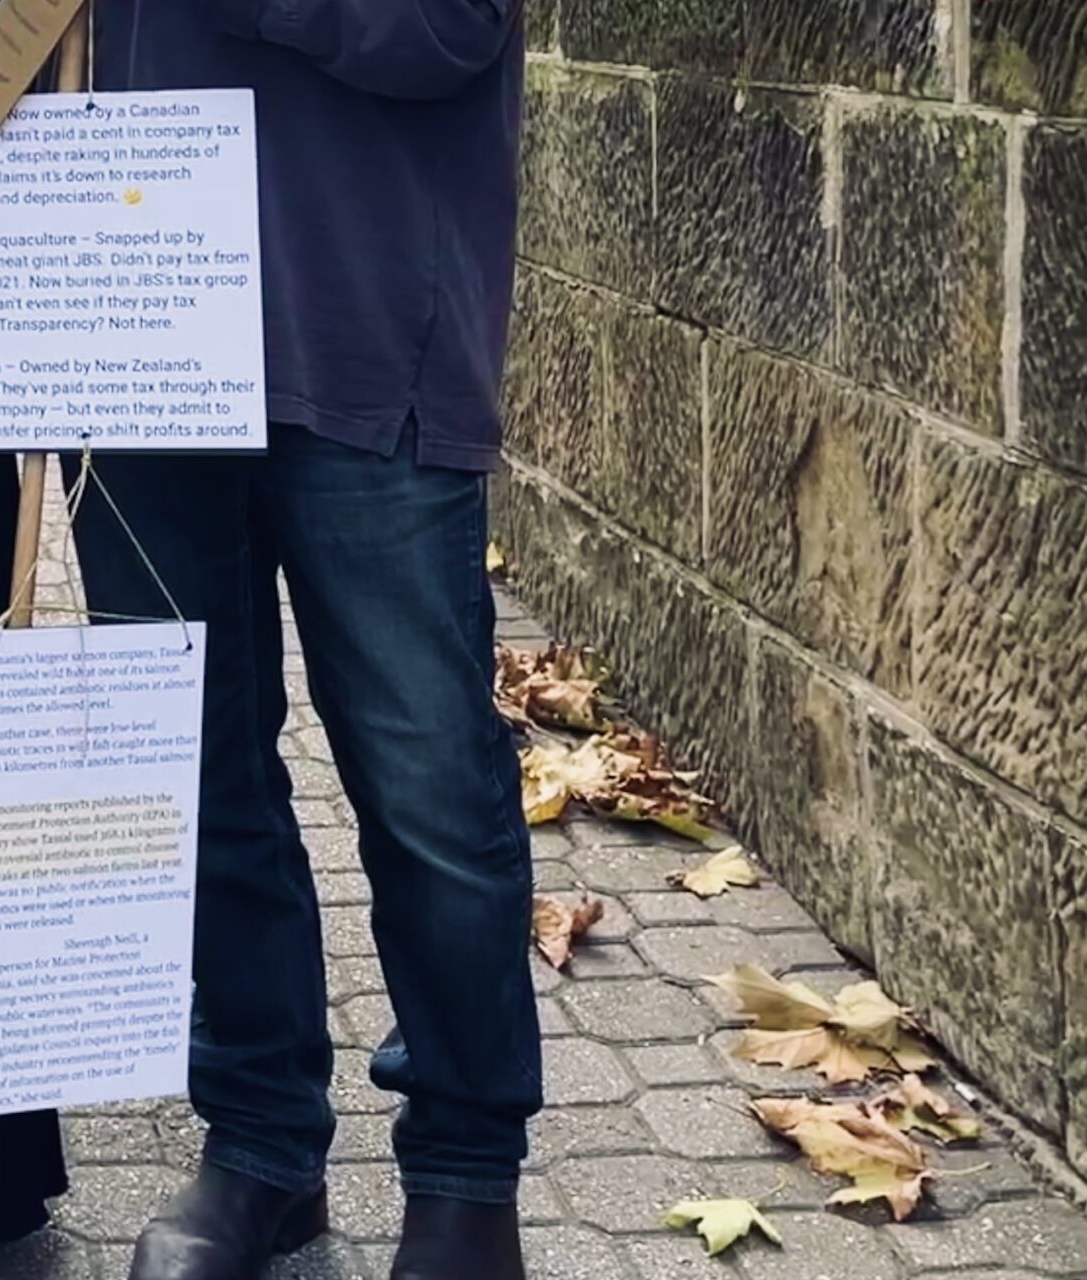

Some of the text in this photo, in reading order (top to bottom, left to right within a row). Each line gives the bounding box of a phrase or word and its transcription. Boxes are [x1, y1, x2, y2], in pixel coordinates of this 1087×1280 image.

[6, 103, 199, 121] Now owned by a Canadian
[42, 127, 75, 142] paid
[78, 129, 87, 139] a
[91, 126, 123, 139] cent
[126, 125, 140, 137] in
[144, 126, 212, 140] company
[216, 124, 239, 136] tax
[7, 148, 60, 164] despite
[64, 147, 110, 163] raking
[114, 148, 127, 159] in
[130, 145, 199, 159] hundreds
[204, 144, 219, 157] of
[65, 168, 104, 181] down
[108, 169, 123, 180] to
[127, 166, 191, 180] research
[23, 189, 119, 206] depreciation.
[96, 230, 160, 247] Snapped
[163, 232, 183, 246] up
[186, 230, 203, 246] by
[32, 254, 69, 269] giant
[74, 252, 106, 266] JBS.
[156, 254, 182, 267] pay
[187, 252, 209, 263] tax
[214, 250, 249, 264] from
[28, 275, 61, 288] Now
[65, 274, 112, 287] buried
[116, 275, 129, 286] in
[177, 274, 200, 285] tax
[204, 274, 247, 288] group
[26, 299, 60, 309] even
[64, 298, 89, 308] see
[93, 295, 103, 307] if
[107, 295, 137, 310] they
[142, 297, 168, 310] pay
[173, 295, 195, 307] tax
[0, 316, 104, 333] Transparency?
[108, 316, 135, 329] Not
[139, 316, 176, 329] here.
[19, 359, 69, 372] Owned
[73, 359, 90, 375] by
[94, 359, 127, 372] New
[51, 380, 83, 396] paid
[88, 383, 128, 393] some
[132, 381, 154, 392] tax
[159, 379, 216, 396] through
[221, 379, 254, 392] their
[67, 401, 90, 415] but
[94, 404, 129, 414] even
[133, 401, 163, 417] they
[169, 401, 211, 414] admit
[215, 402, 230, 414] to
[33, 426, 86, 440] pricing
[85, 425, 102, 436] to
[107, 423, 139, 435] shift
[143, 423, 191, 438] profits
[196, 423, 253, 436] around.
